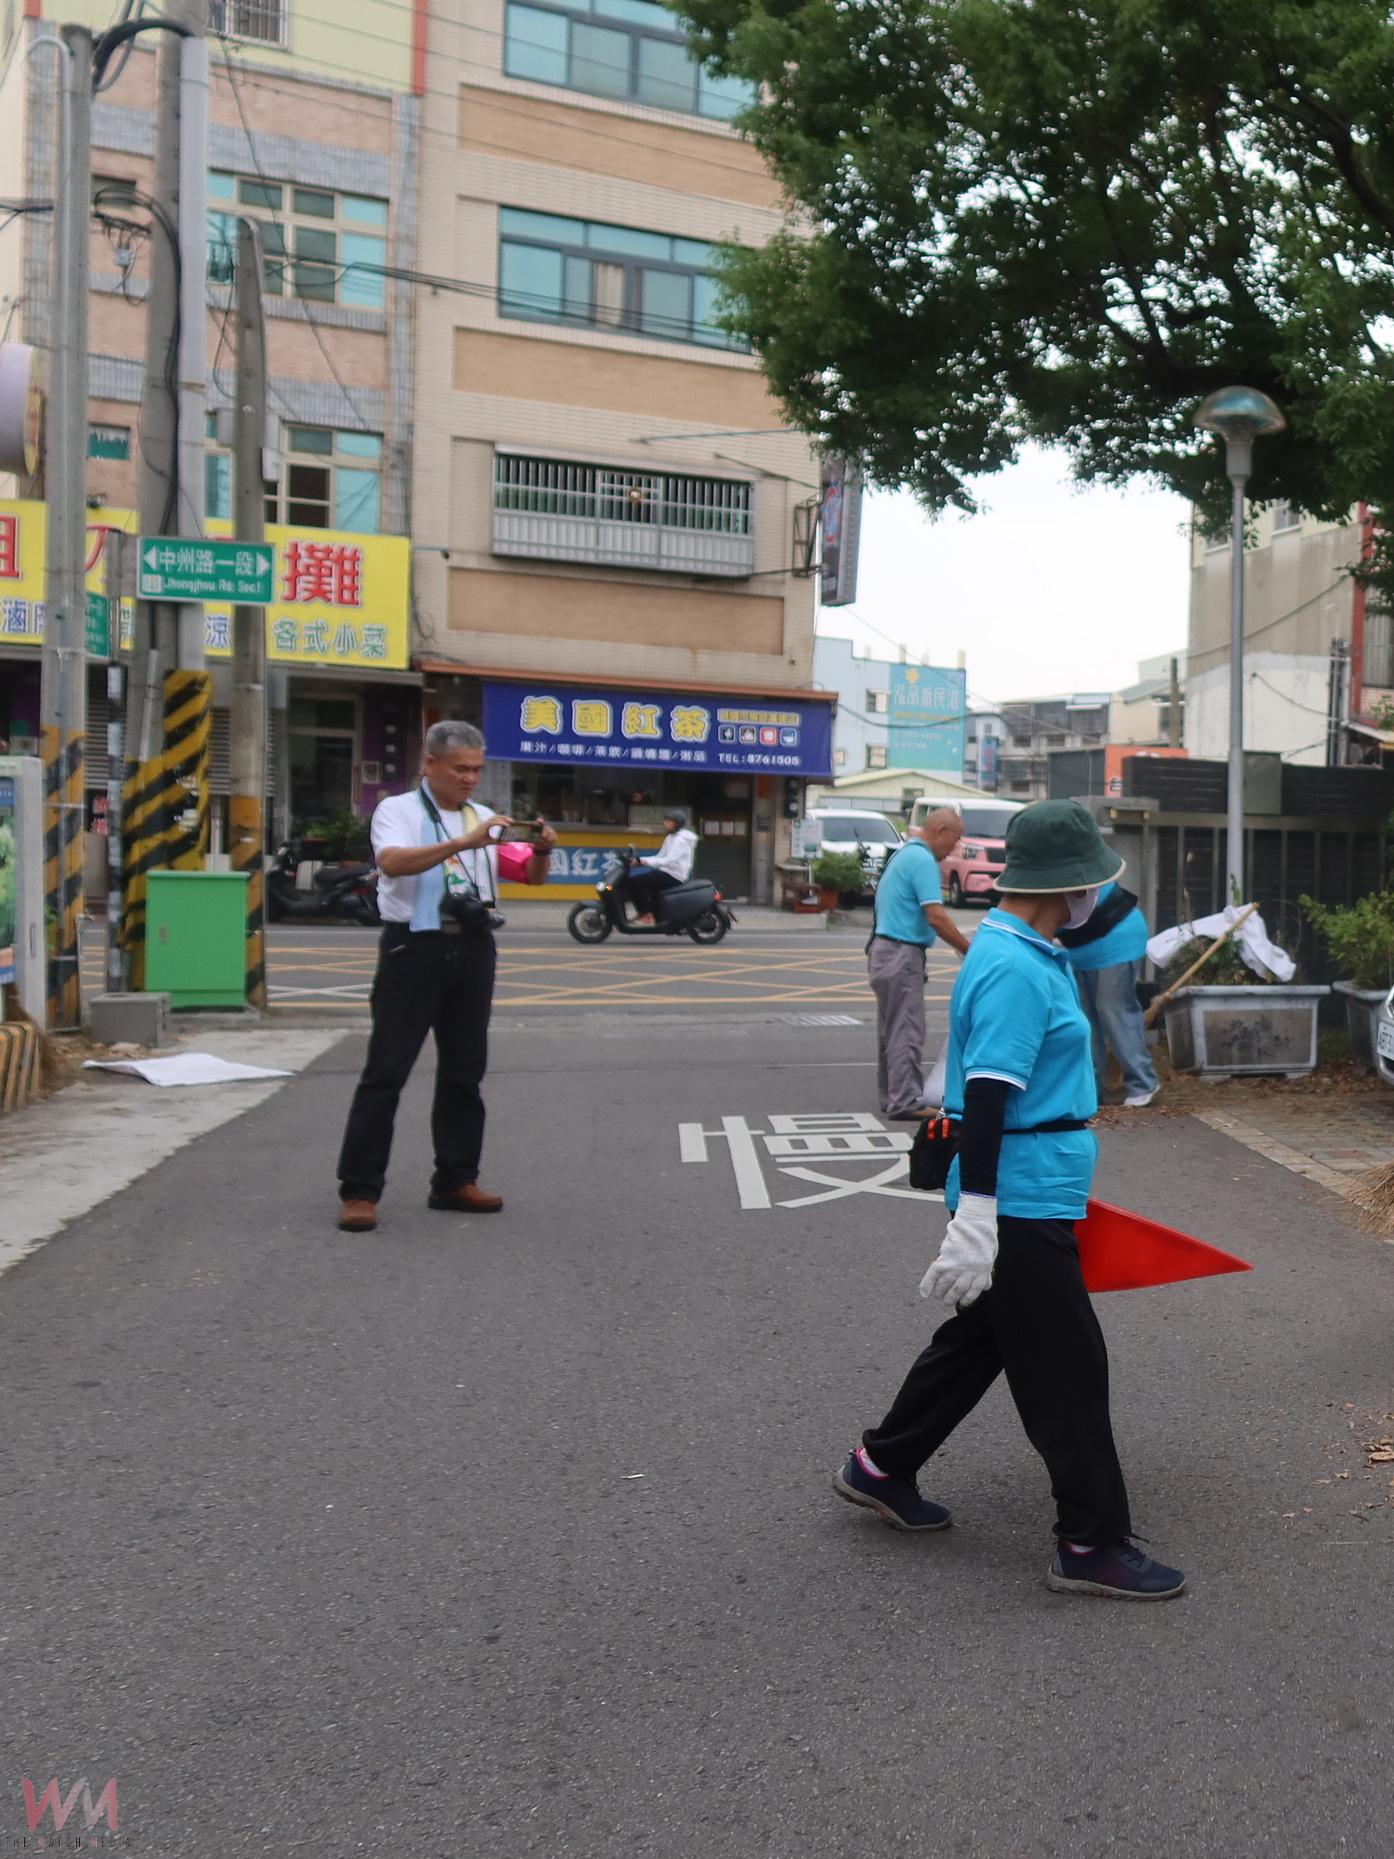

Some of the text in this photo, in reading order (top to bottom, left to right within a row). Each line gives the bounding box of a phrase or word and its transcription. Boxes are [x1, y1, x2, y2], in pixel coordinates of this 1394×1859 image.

[159, 547, 254, 576] 中州路一段
[281, 541, 361, 606] 攤
[273, 618, 386, 659] 各式小菜
[521, 696, 711, 743] 美國紅茶
[678, 1112, 946, 1209] 慢
